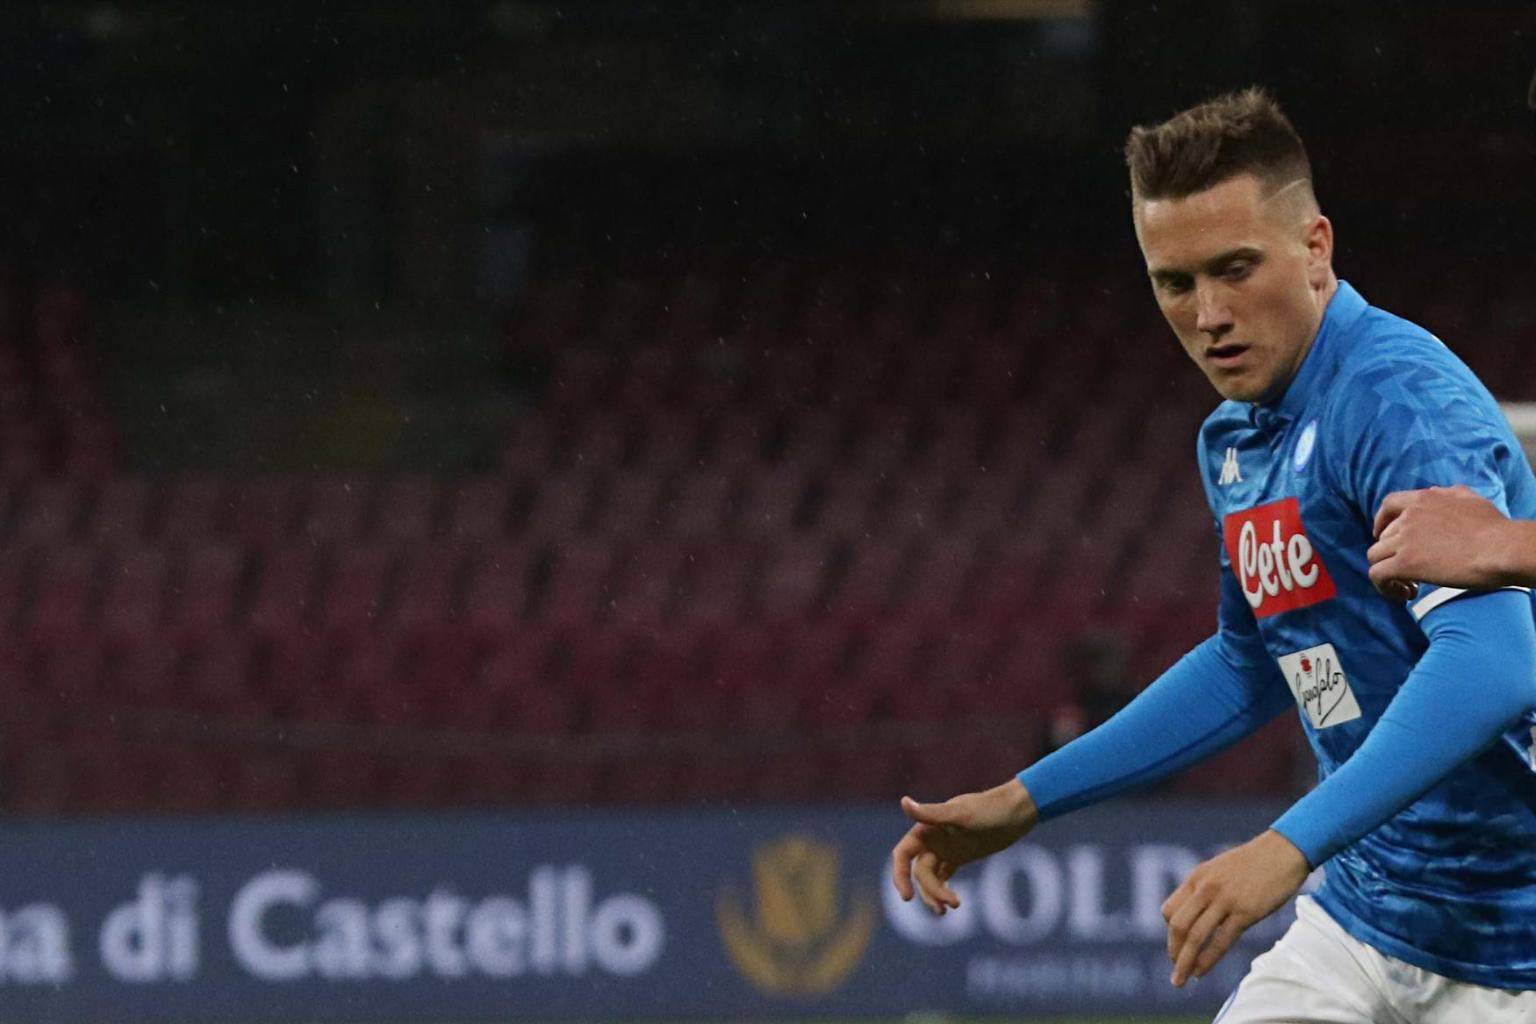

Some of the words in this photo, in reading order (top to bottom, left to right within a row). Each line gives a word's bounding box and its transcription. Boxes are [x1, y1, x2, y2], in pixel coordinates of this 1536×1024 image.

[1238, 519, 1319, 608] Lete
[0, 902, 72, 982] a
[100, 872, 196, 982] di
[227, 864, 664, 982] Castello
